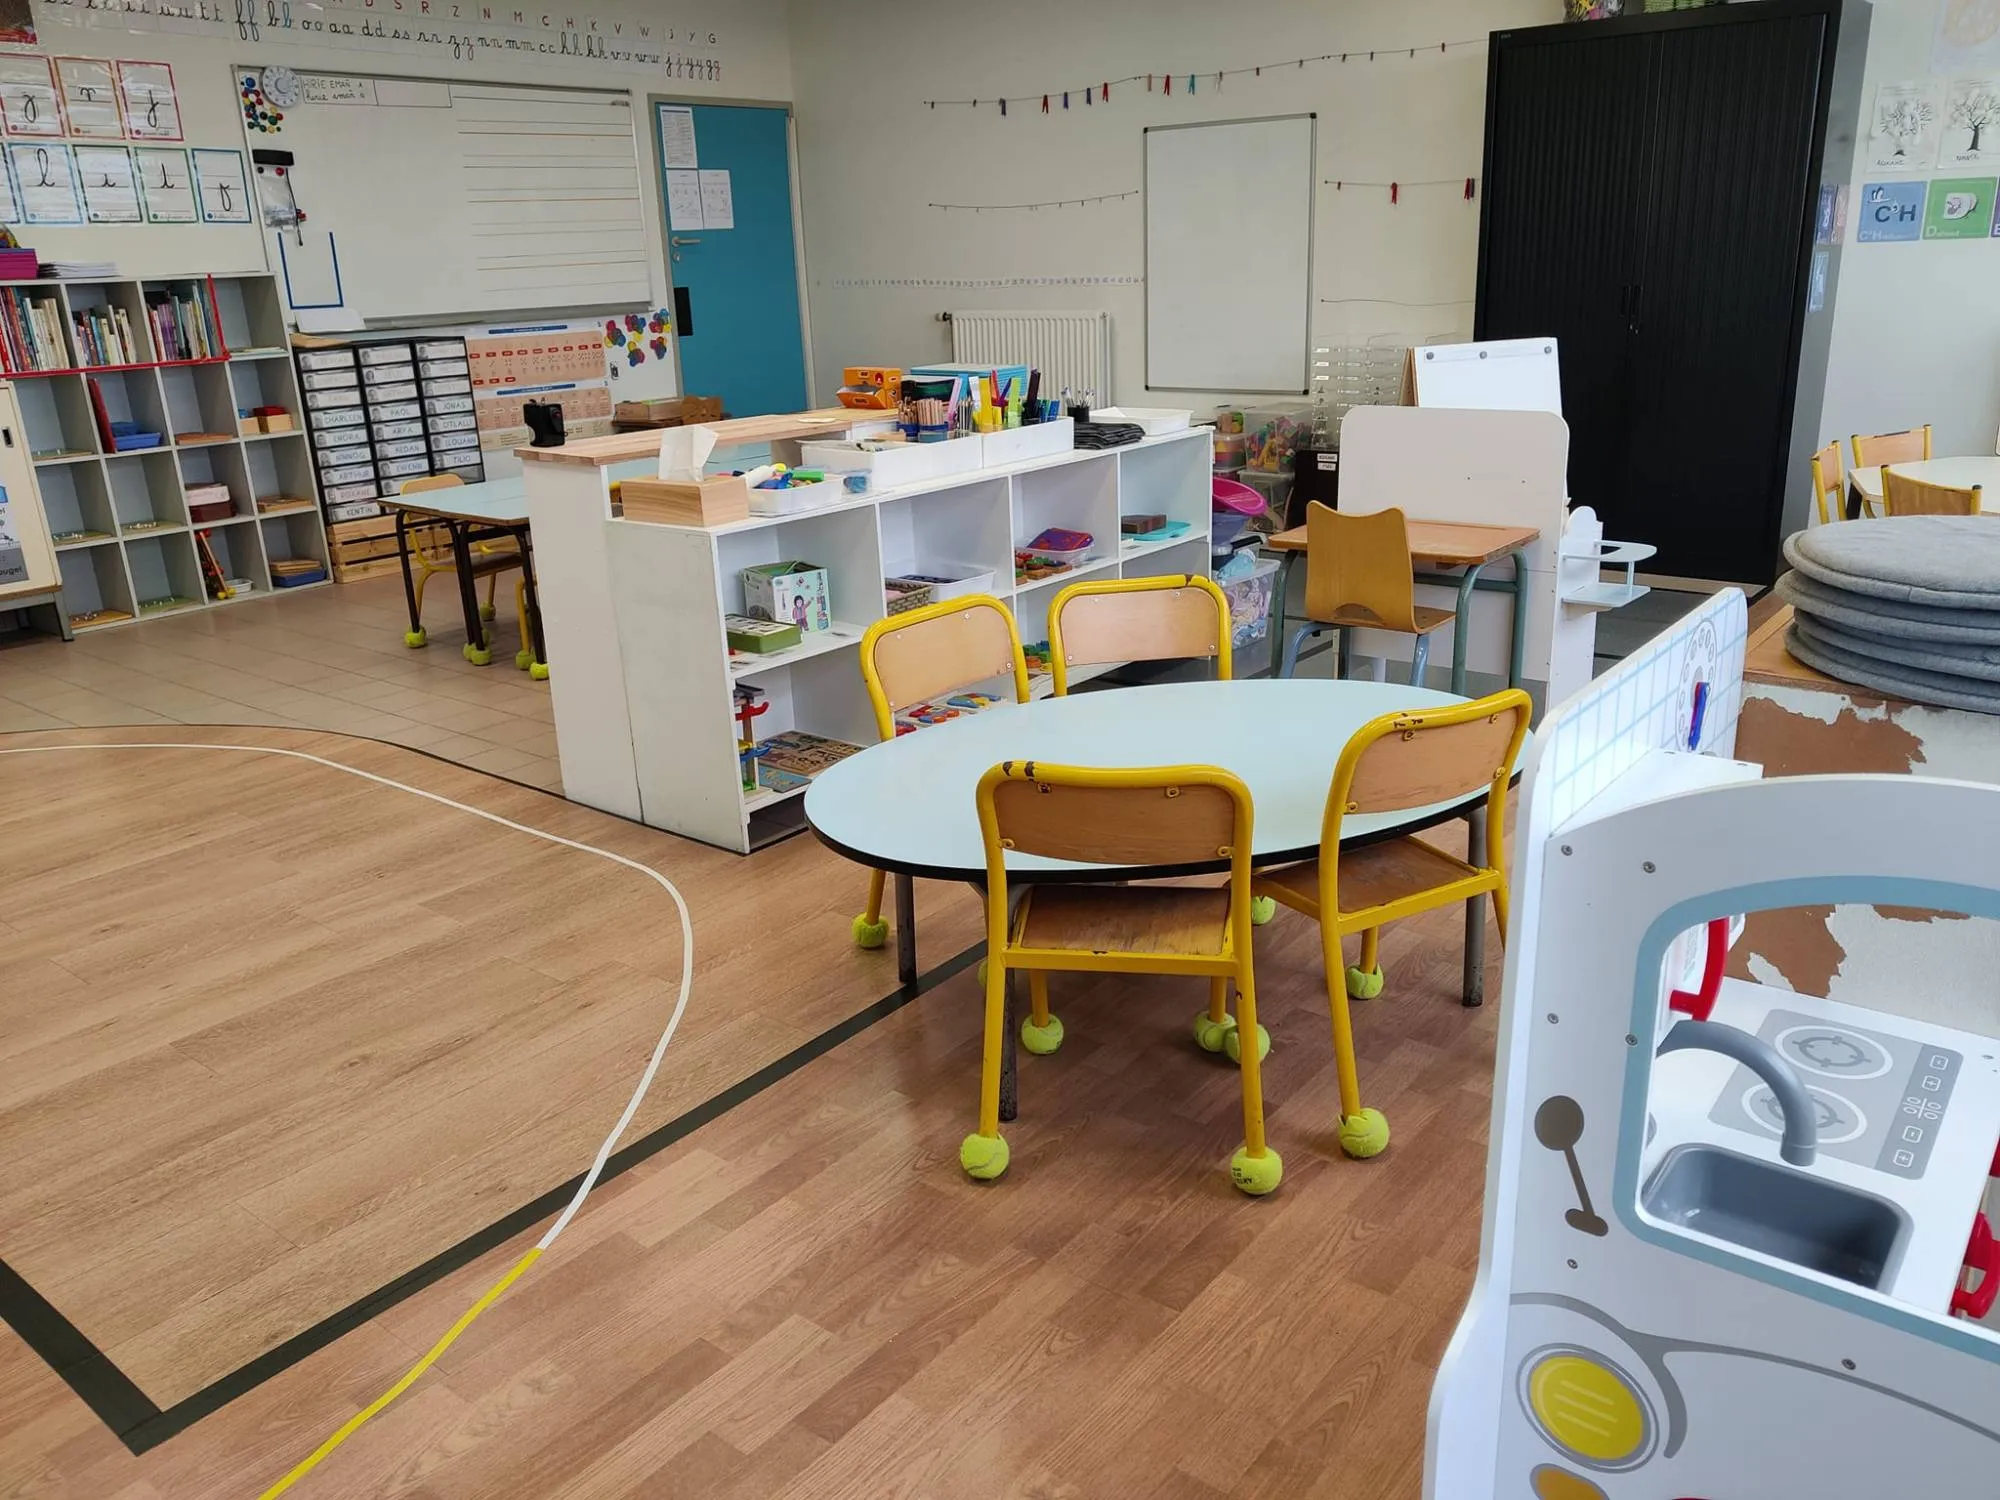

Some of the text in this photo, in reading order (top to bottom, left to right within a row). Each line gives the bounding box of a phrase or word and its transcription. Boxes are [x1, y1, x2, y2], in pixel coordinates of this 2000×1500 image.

[422, 1, 431, 14] R
[452, 6, 460, 17] Z
[483, 8, 491, 20] N
[514, 11, 523, 22] M
[542, 15, 550, 26] C
[566, 17, 574, 29] H
